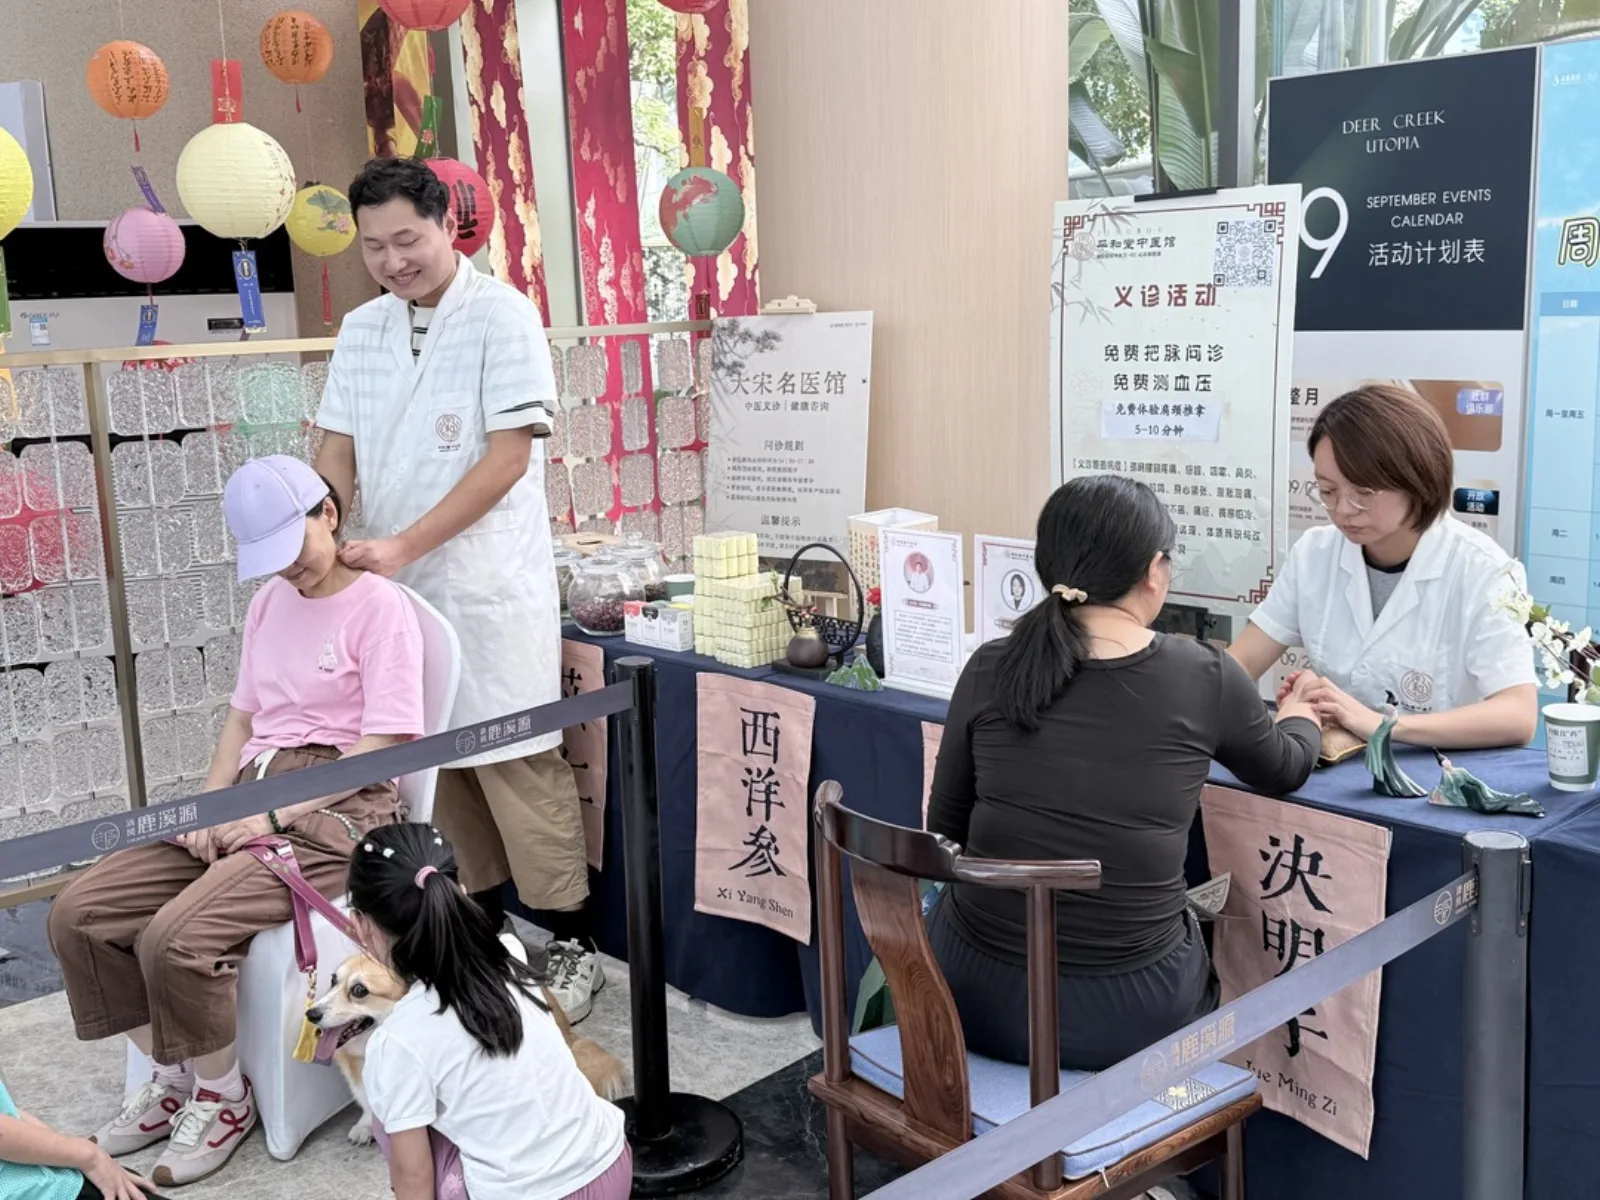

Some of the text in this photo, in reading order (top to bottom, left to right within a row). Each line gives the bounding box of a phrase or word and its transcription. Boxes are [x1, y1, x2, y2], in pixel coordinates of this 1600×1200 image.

[1342, 110, 1446, 134] DEER CREEK
[1365, 136, 1420, 153] UTOPIA
[1366, 188, 1492, 209] SEPTEMBER EVENTS
[1390, 212, 1464, 228] CALENDAR
[1368, 238, 1485, 267] 活动计划表
[1113, 283, 1217, 308] 义诊活动
[1103, 344, 1224, 363] 免费把脉问诊
[1113, 373, 1213, 392] 免费测血压
[1115, 403, 1207, 417] 免费体验肩颈推拿
[764, 440, 804, 451] 问诊规则
[761, 514, 801, 526] 温馨提示
[717, 886, 794, 919] Xi Yang Shen
[1278, 1072, 1317, 1109] Ming
[1322, 1095, 1338, 1116] Zi
